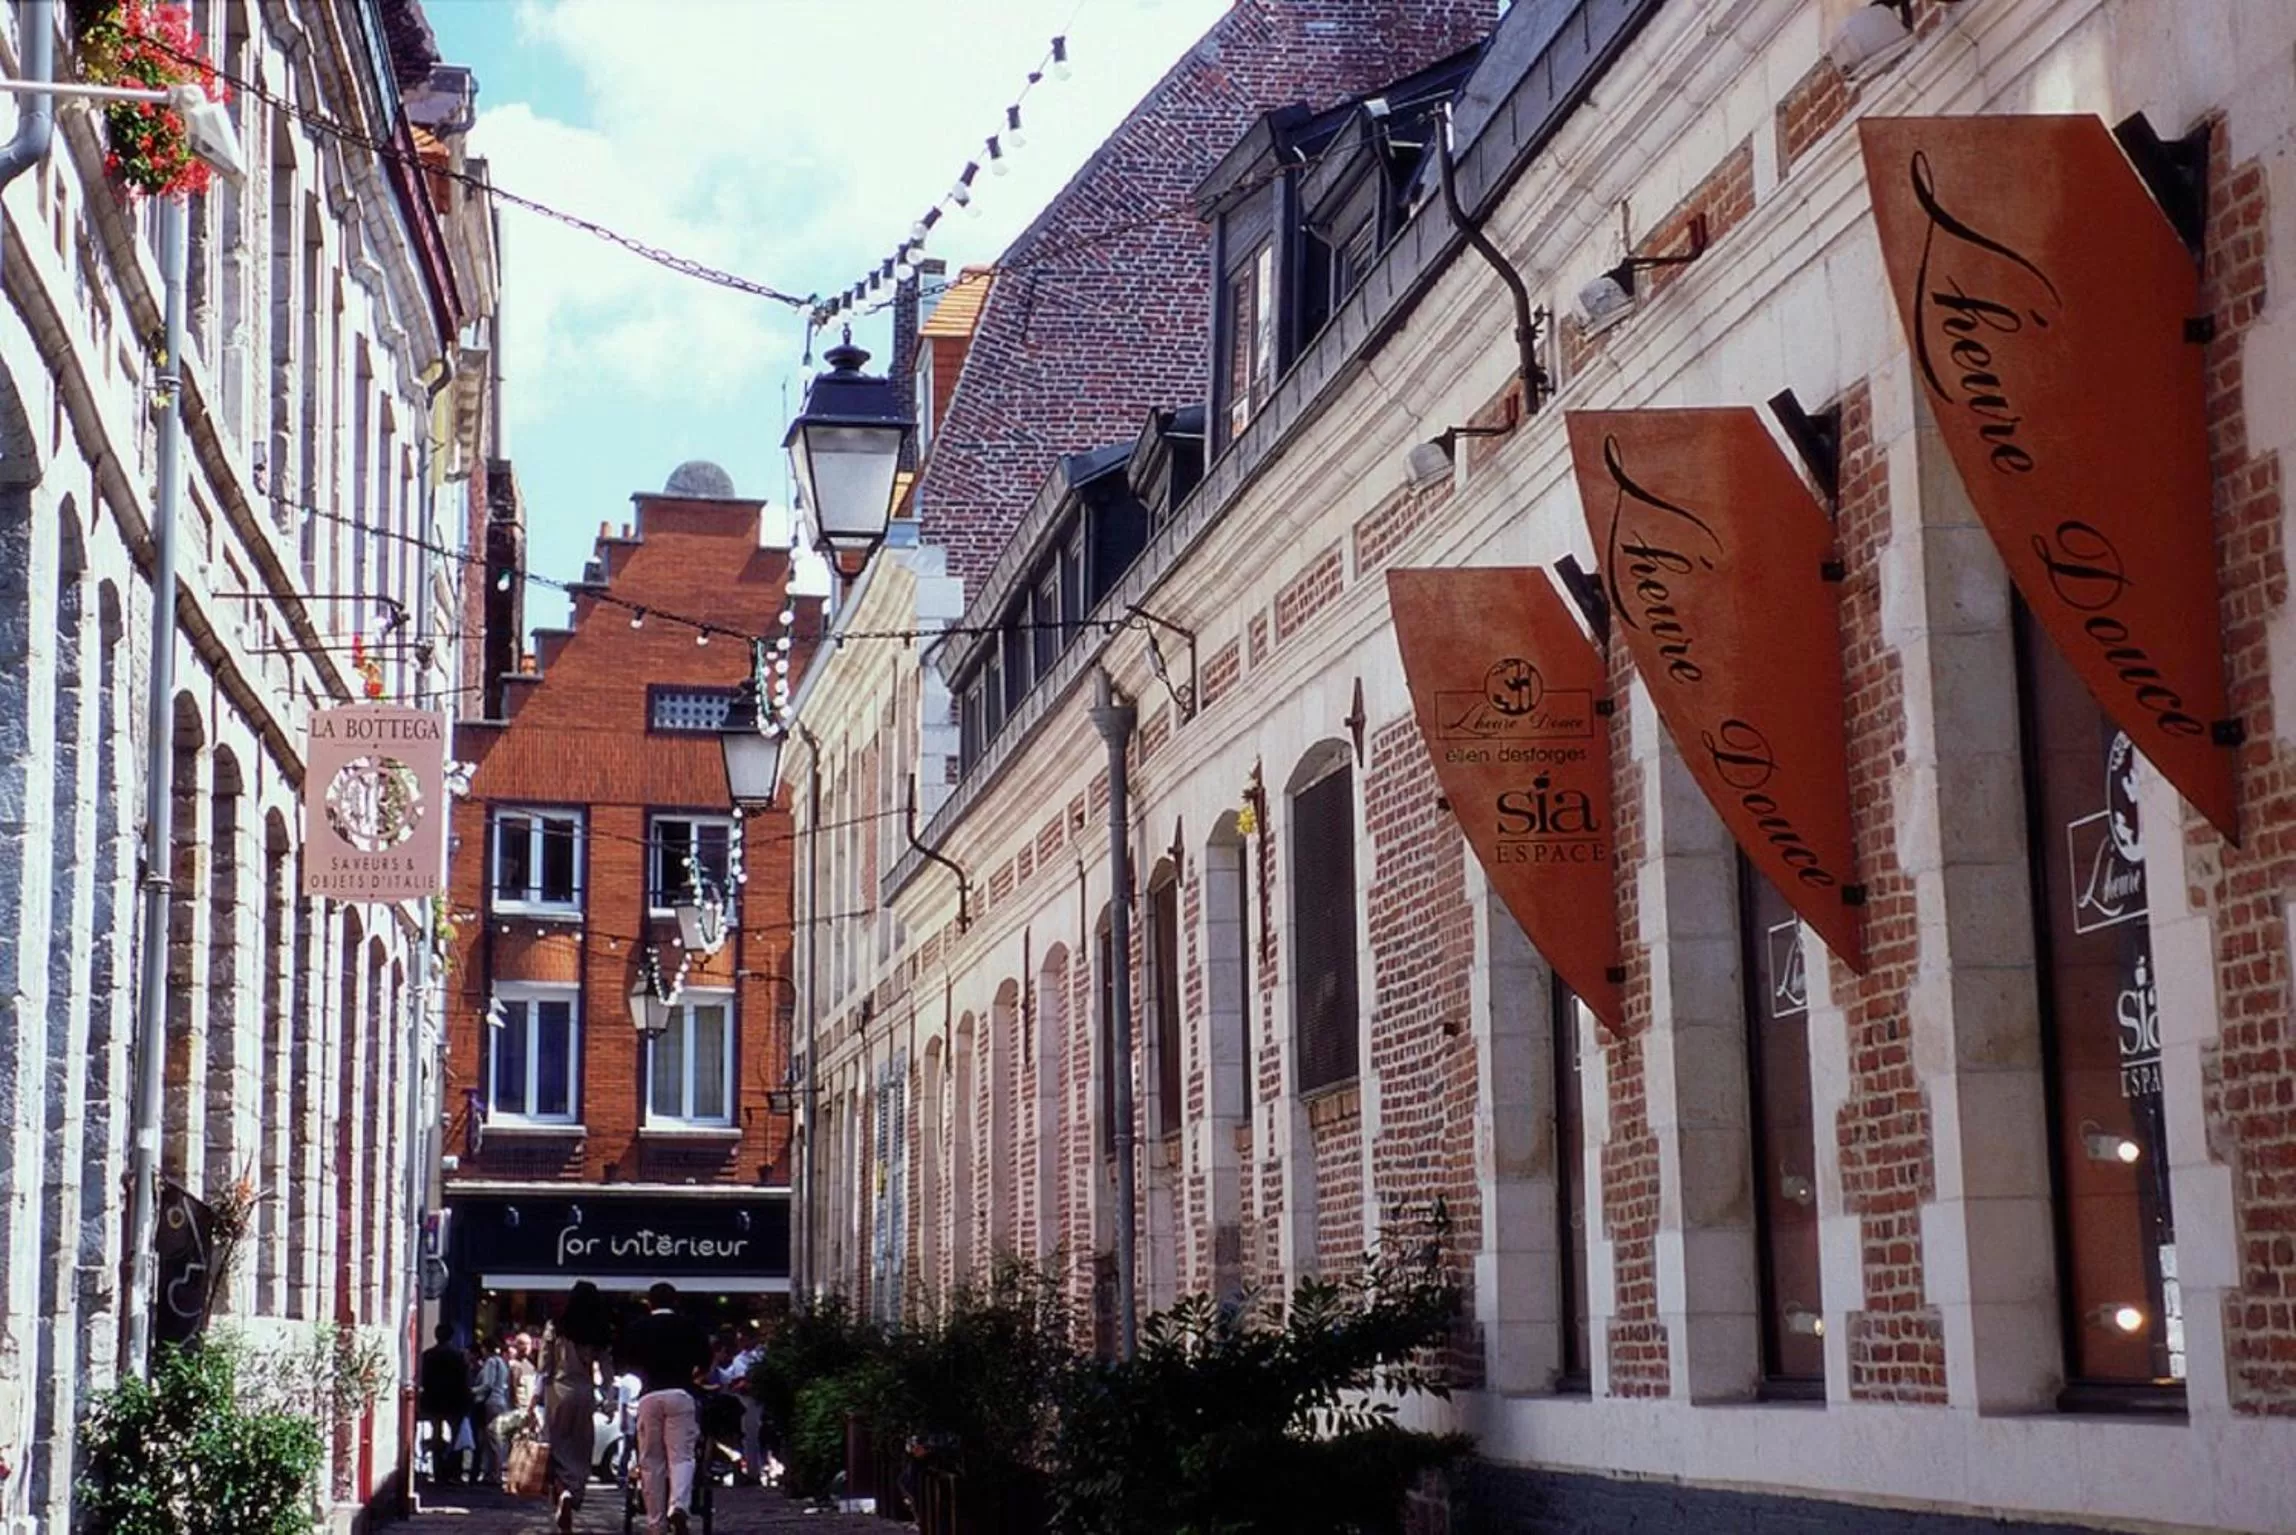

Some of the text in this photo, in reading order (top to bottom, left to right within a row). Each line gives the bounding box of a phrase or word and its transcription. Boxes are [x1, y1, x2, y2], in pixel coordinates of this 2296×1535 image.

[1910, 150, 2206, 740] L'heure Douce
[1603, 433, 1837, 890] L'heure Douce
[310, 718, 441, 740] LA BOTTEGA
[1497, 745, 1586, 765] desforges
[1496, 770, 1602, 836] sia
[331, 857, 415, 871] SAVEURS &
[1496, 843, 1606, 864] ESPACE
[310, 874, 435, 889] OBJETS D'ITALIE
[2120, 1065, 2162, 1098] ESPA
